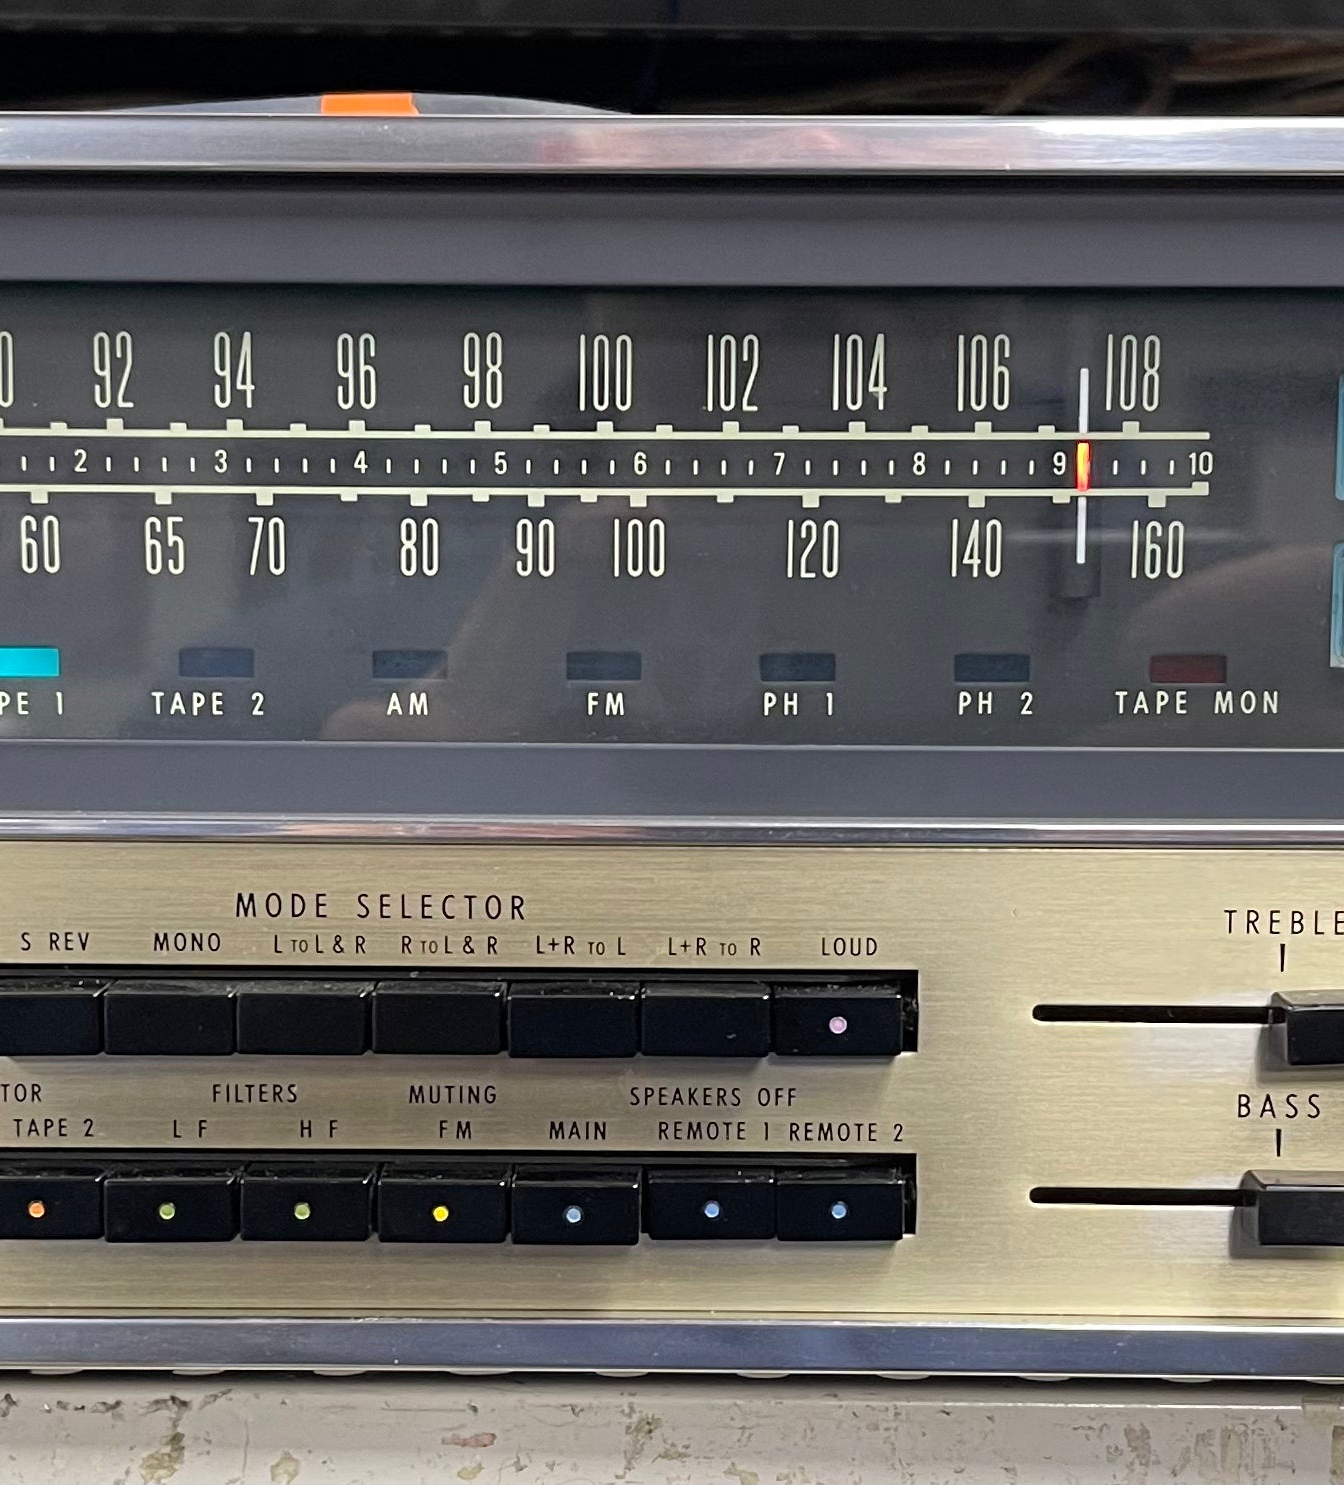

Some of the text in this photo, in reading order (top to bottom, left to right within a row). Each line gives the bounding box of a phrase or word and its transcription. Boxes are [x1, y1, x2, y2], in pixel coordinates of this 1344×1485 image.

[93, 331, 134, 409] 92
[214, 331, 255, 409] 94
[337, 333, 376, 410] 96
[463, 332, 503, 409] 98
[579, 334, 632, 412] 100
[707, 334, 759, 412] 102
[832, 333, 888, 411] 104
[957, 334, 1010, 412] 106
[1105, 333, 1161, 412] 108
[74, 448, 87, 473] 2
[214, 449, 228, 473] 3
[353, 450, 368, 474] 4
[494, 451, 508, 475] 5
[633, 451, 647, 476] 6
[773, 452, 785, 476] 7
[912, 451, 926, 476] 8
[1053, 451, 1066, 476] 9
[1189, 451, 1213, 476] 10
[20, 515, 60, 574] 60
[144, 516, 185, 575] 65
[248, 516, 286, 576] 70
[400, 517, 439, 577] 80
[516, 518, 555, 578] 90
[614, 518, 665, 578] 100
[787, 519, 839, 579] 120
[951, 518, 1002, 578] 140
[1131, 519, 1185, 580] 160
[56, 691, 63, 715] 1
[151, 691, 264, 716] TAPE 2
[386, 692, 428, 716] AM
[587, 692, 625, 716] FM
[763, 692, 833, 716] PH 1
[958, 691, 1033, 716] PH 2
[1115, 690, 1278, 715] TAPE MON
[235, 892, 525, 921] MODE SELECTOR
[21, 931, 90, 952] S REV
[153, 932, 221, 952] MONO
[536, 934, 575, 955] L+R
[668, 936, 707, 956] L+R
[821, 937, 878, 957] LOUD
[212, 1083, 297, 1104] FILTERS
[408, 1084, 497, 1105] MUTING
[629, 1086, 797, 1107] SPEAKERS OFF
[1237, 1093, 1321, 1119] BASS
[13, 1117, 94, 1138] TAPE 2
[439, 1119, 472, 1140] FM
[549, 1120, 607, 1141] MAIN
[658, 1120, 769, 1141] REMOTE 1
[789, 1122, 903, 1142] REMOTE 2
